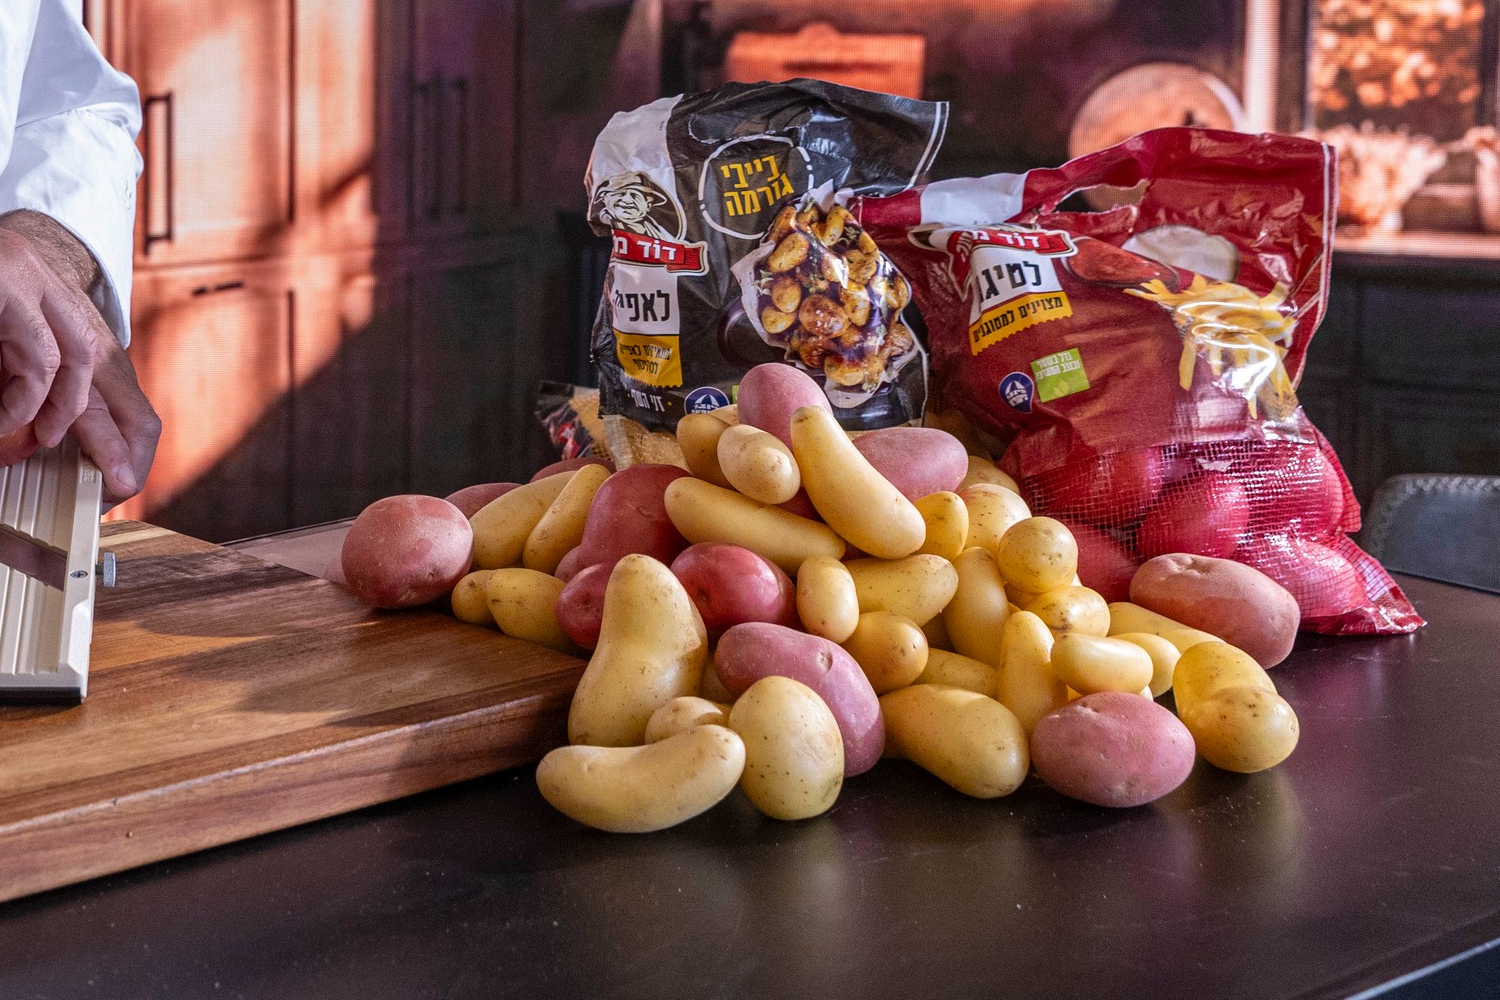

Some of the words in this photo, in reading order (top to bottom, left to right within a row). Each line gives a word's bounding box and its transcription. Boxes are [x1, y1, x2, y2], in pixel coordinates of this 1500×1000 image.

[720, 155, 779, 189] בייבי
[723, 173, 794, 217] גורמה
[1018, 296, 1063, 319] מצוינים
[972, 310, 1016, 343] למטוגנים
